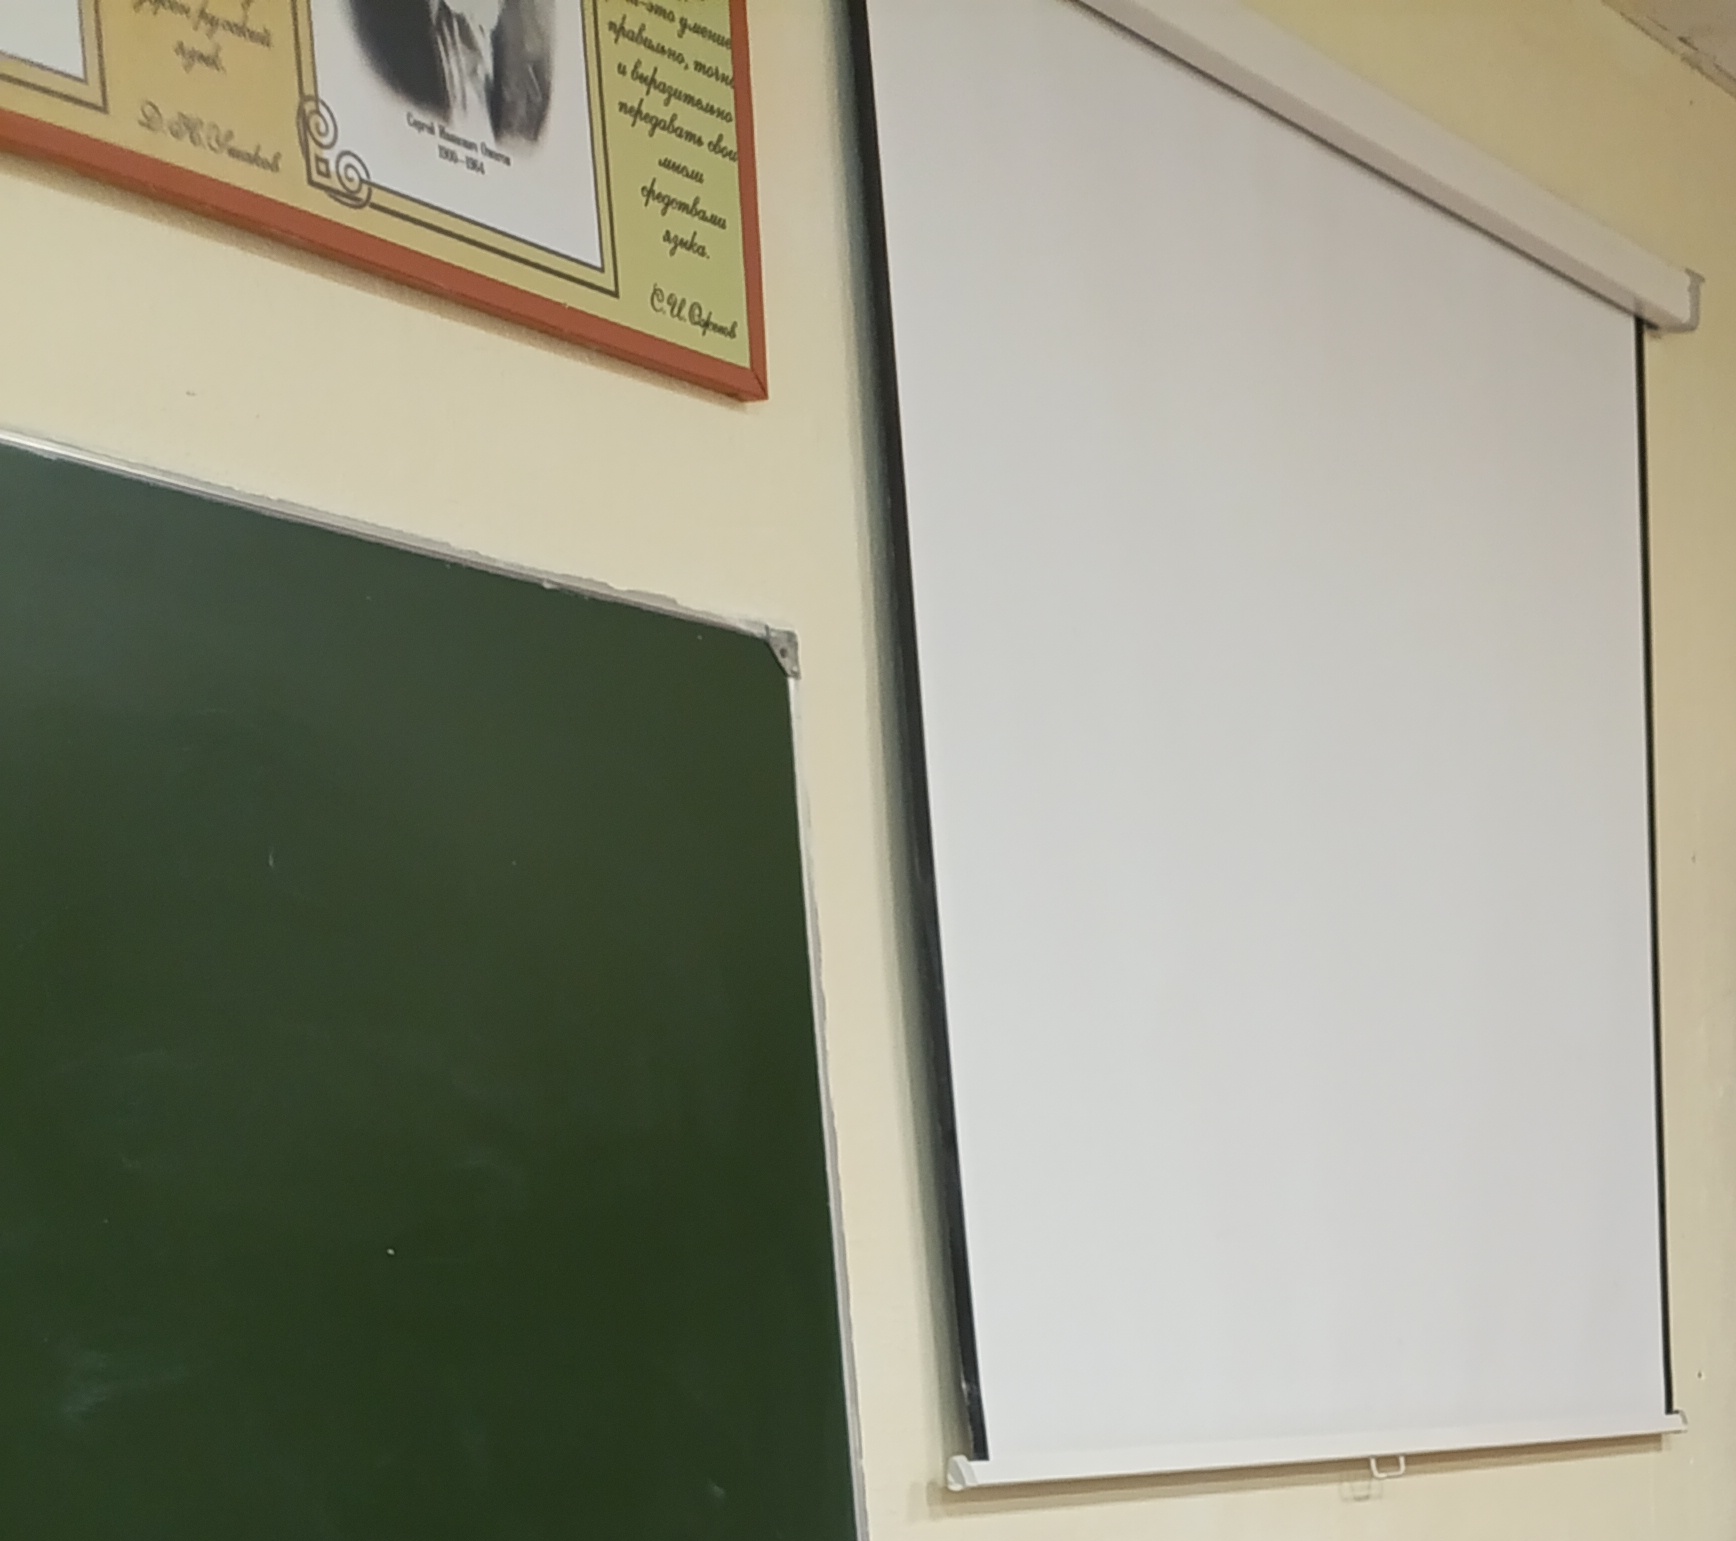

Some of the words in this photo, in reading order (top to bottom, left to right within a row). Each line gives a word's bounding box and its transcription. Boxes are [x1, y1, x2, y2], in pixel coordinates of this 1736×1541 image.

[608, 13, 689, 70] правильно,
[631, 59, 733, 123] выразительно
[618, 98, 704, 147] передавать
[641, 177, 727, 230] средствами
